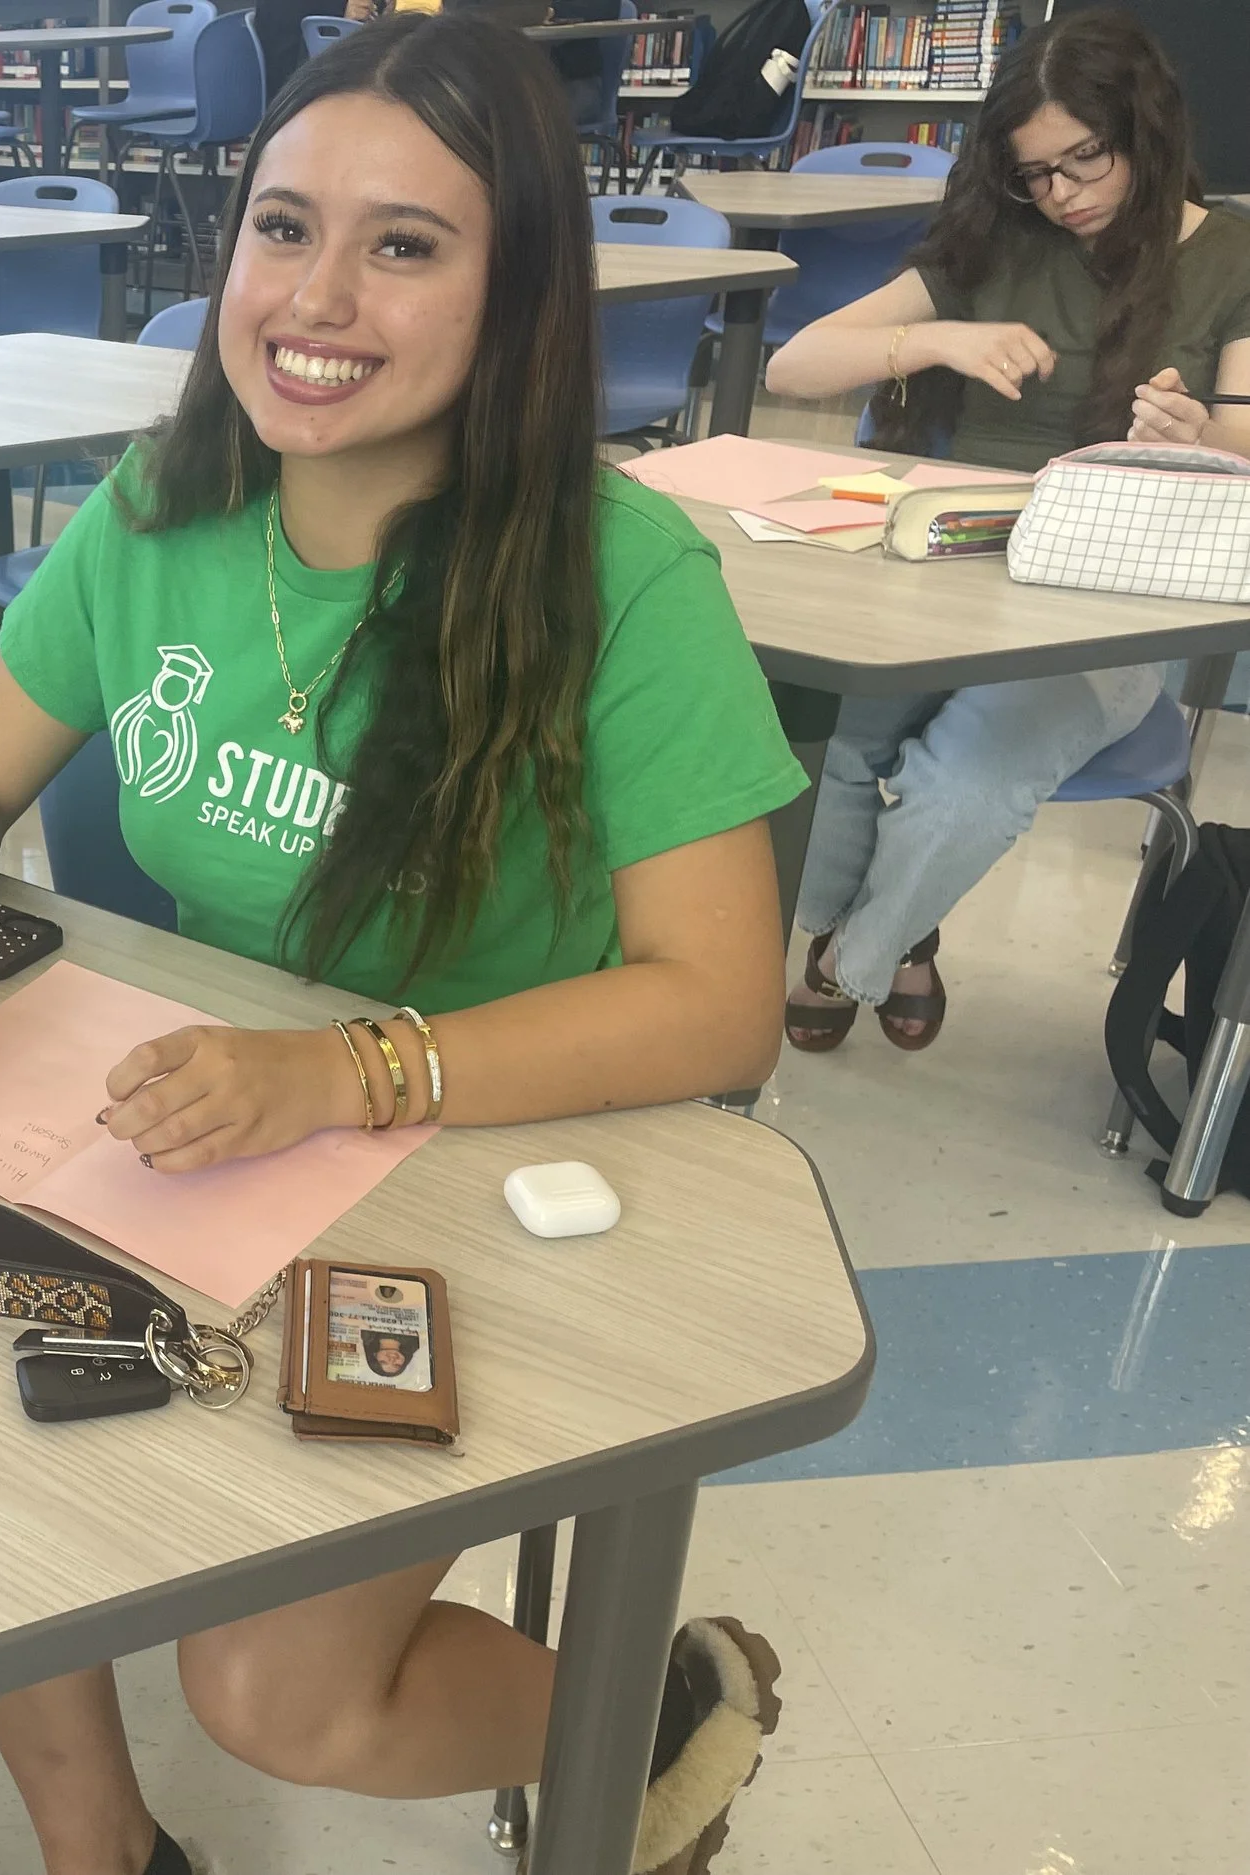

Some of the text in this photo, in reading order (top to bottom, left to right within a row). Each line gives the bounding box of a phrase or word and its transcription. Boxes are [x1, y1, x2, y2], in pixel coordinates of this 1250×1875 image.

[207, 741, 351, 837] STUDE
[197, 801, 316, 858] SPEAK UP
[13, 1139, 52, 1168] having
